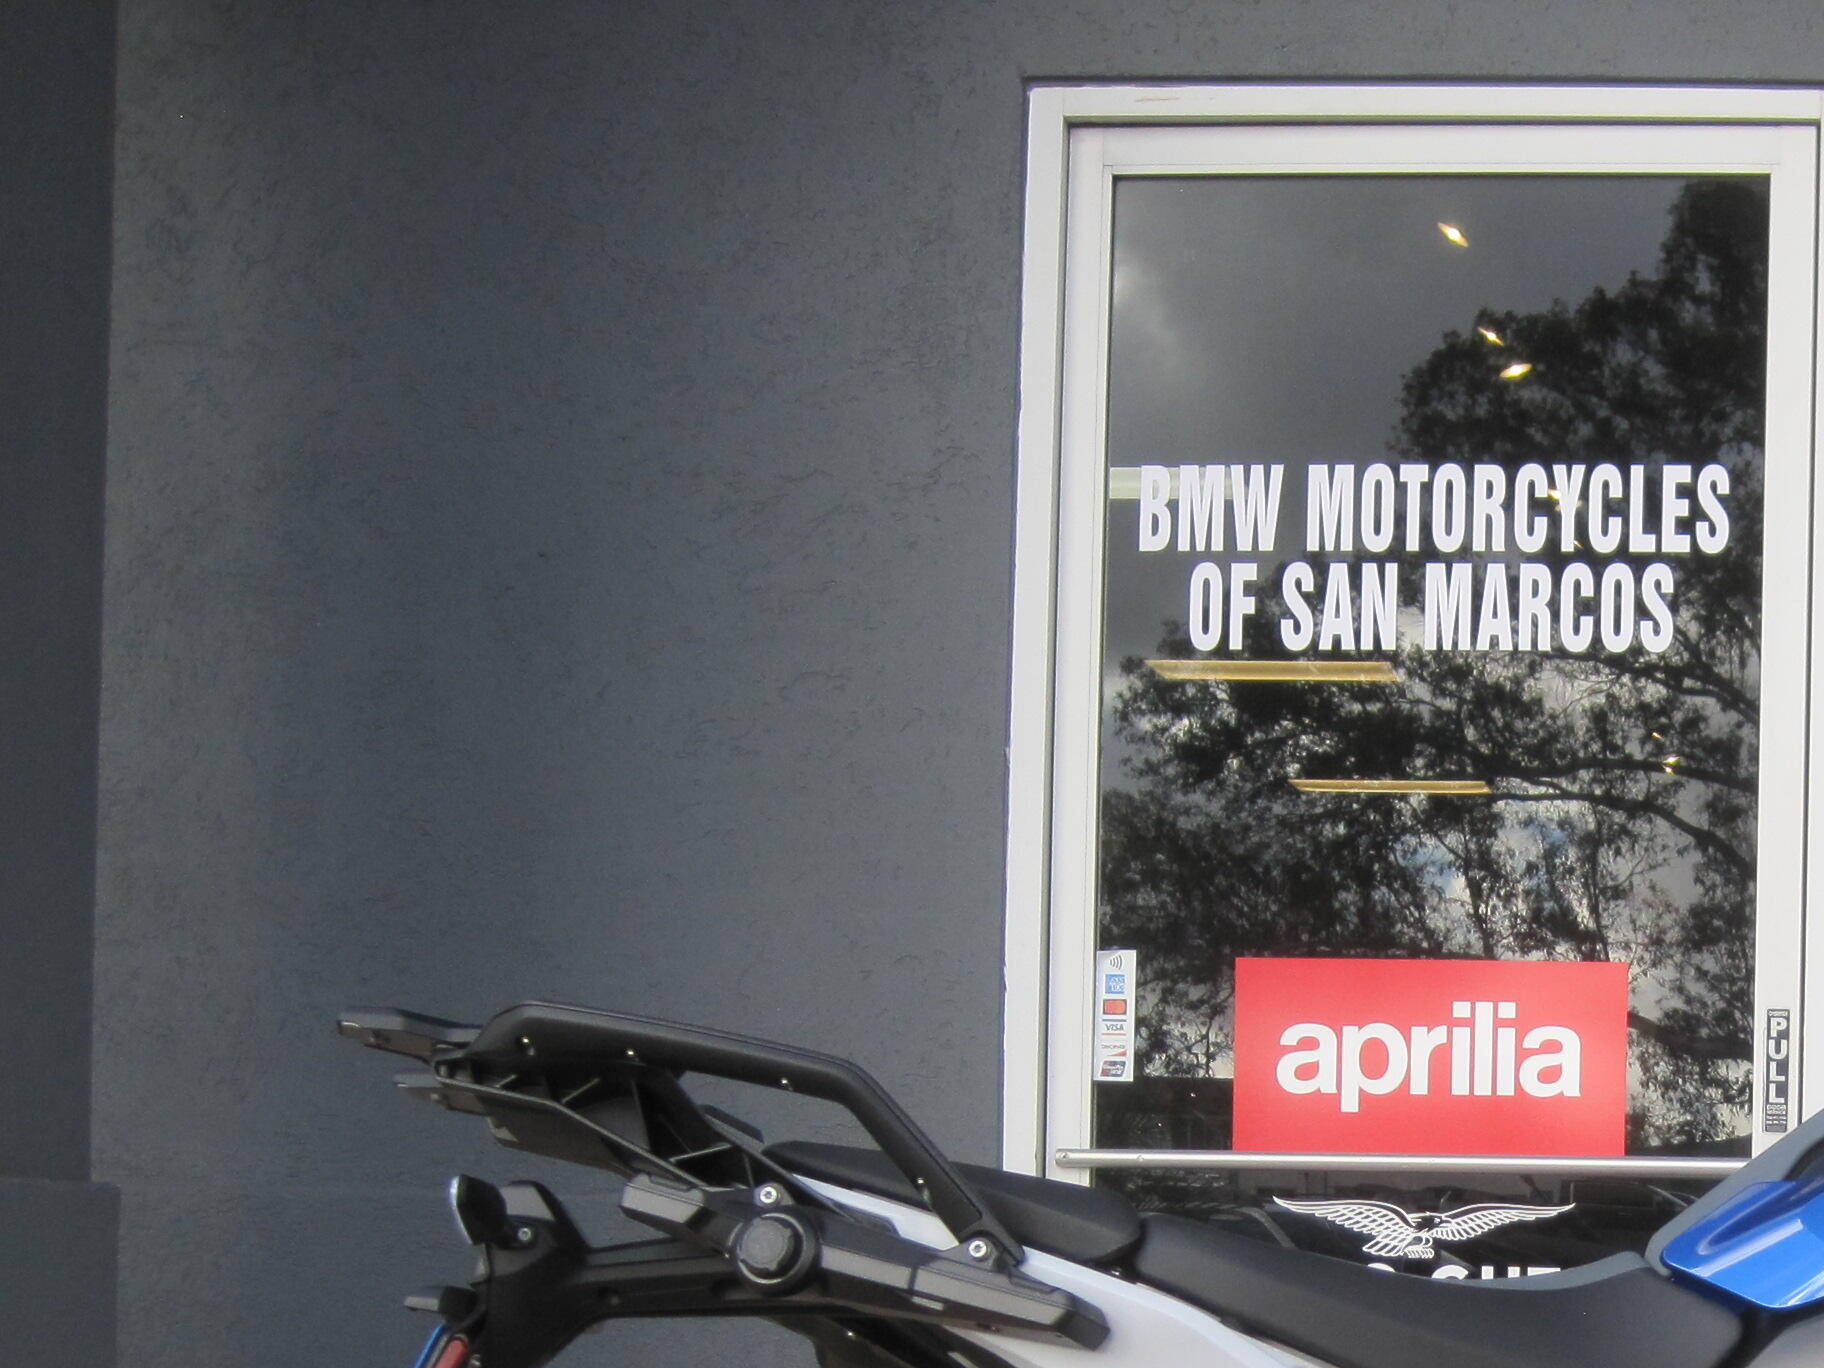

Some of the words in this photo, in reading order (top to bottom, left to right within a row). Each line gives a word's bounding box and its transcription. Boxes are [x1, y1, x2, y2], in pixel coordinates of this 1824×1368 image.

[1139, 464, 1284, 552] BMW
[1306, 464, 1730, 553] MOTORCYCLES
[1189, 562, 1257, 651] OF
[1281, 562, 1398, 652] SAN
[1424, 562, 1675, 653] MARCOS
[1275, 1001, 1581, 1113] aprilia
[1768, 1017, 1788, 1104] PULL
